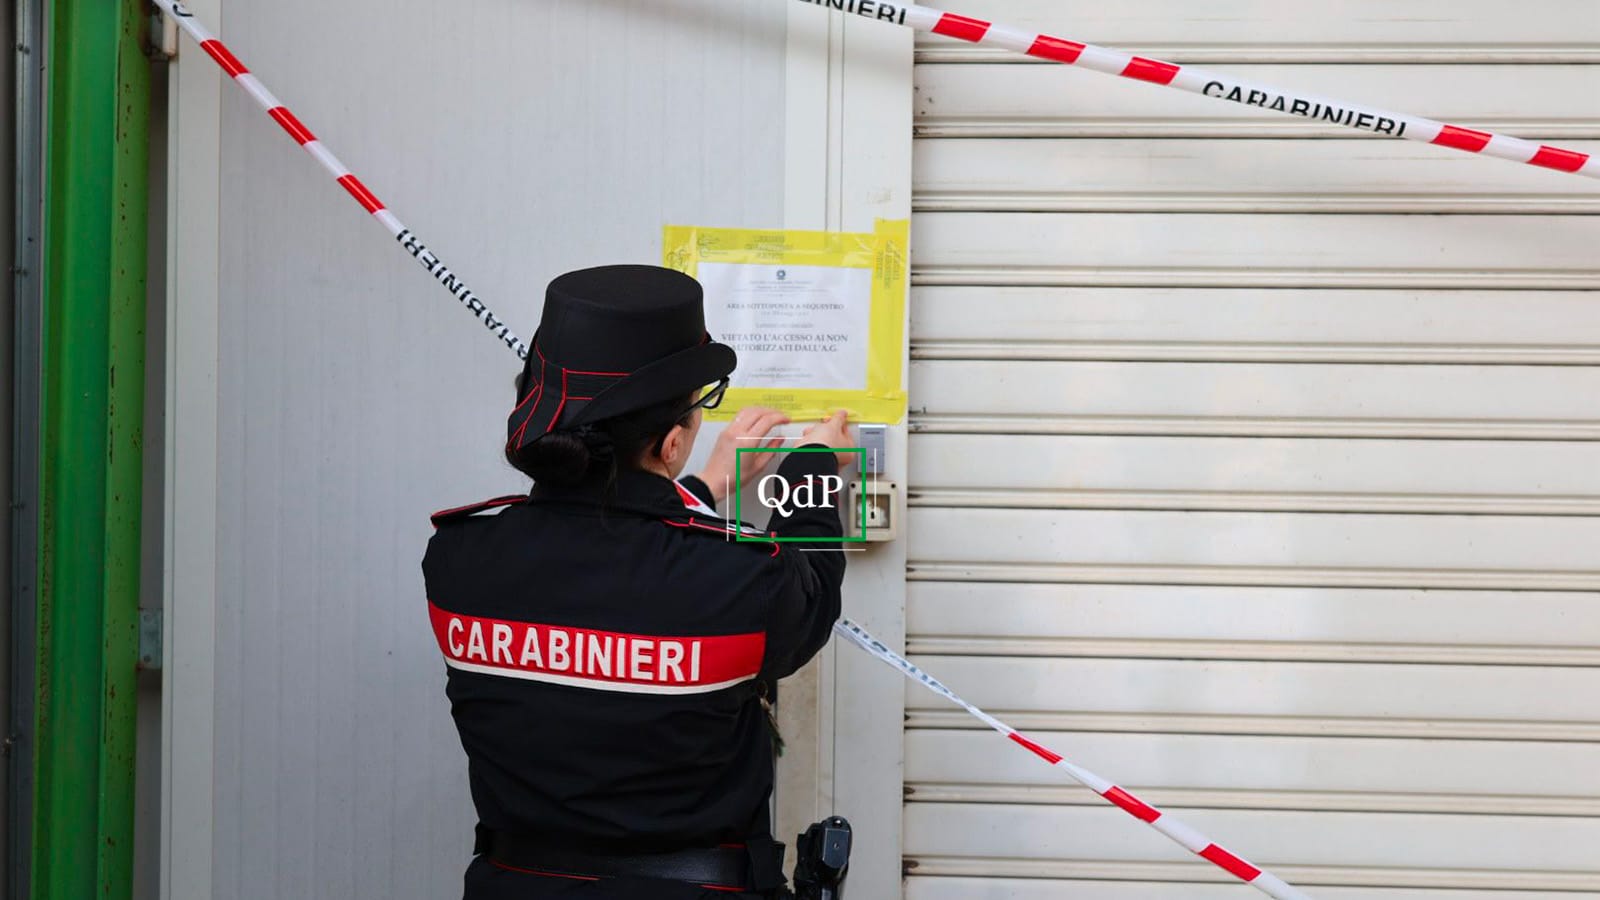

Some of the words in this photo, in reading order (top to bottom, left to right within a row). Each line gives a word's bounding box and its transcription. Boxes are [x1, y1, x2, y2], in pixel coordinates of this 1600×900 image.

[396, 229, 528, 361] ARABINIERI
[721, 333, 762, 342] VIETATO
[763, 333, 813, 342] L'ACCESSO
[814, 333, 826, 343] AI
[826, 333, 849, 343] NON
[447, 616, 702, 682] CARABINIERI
